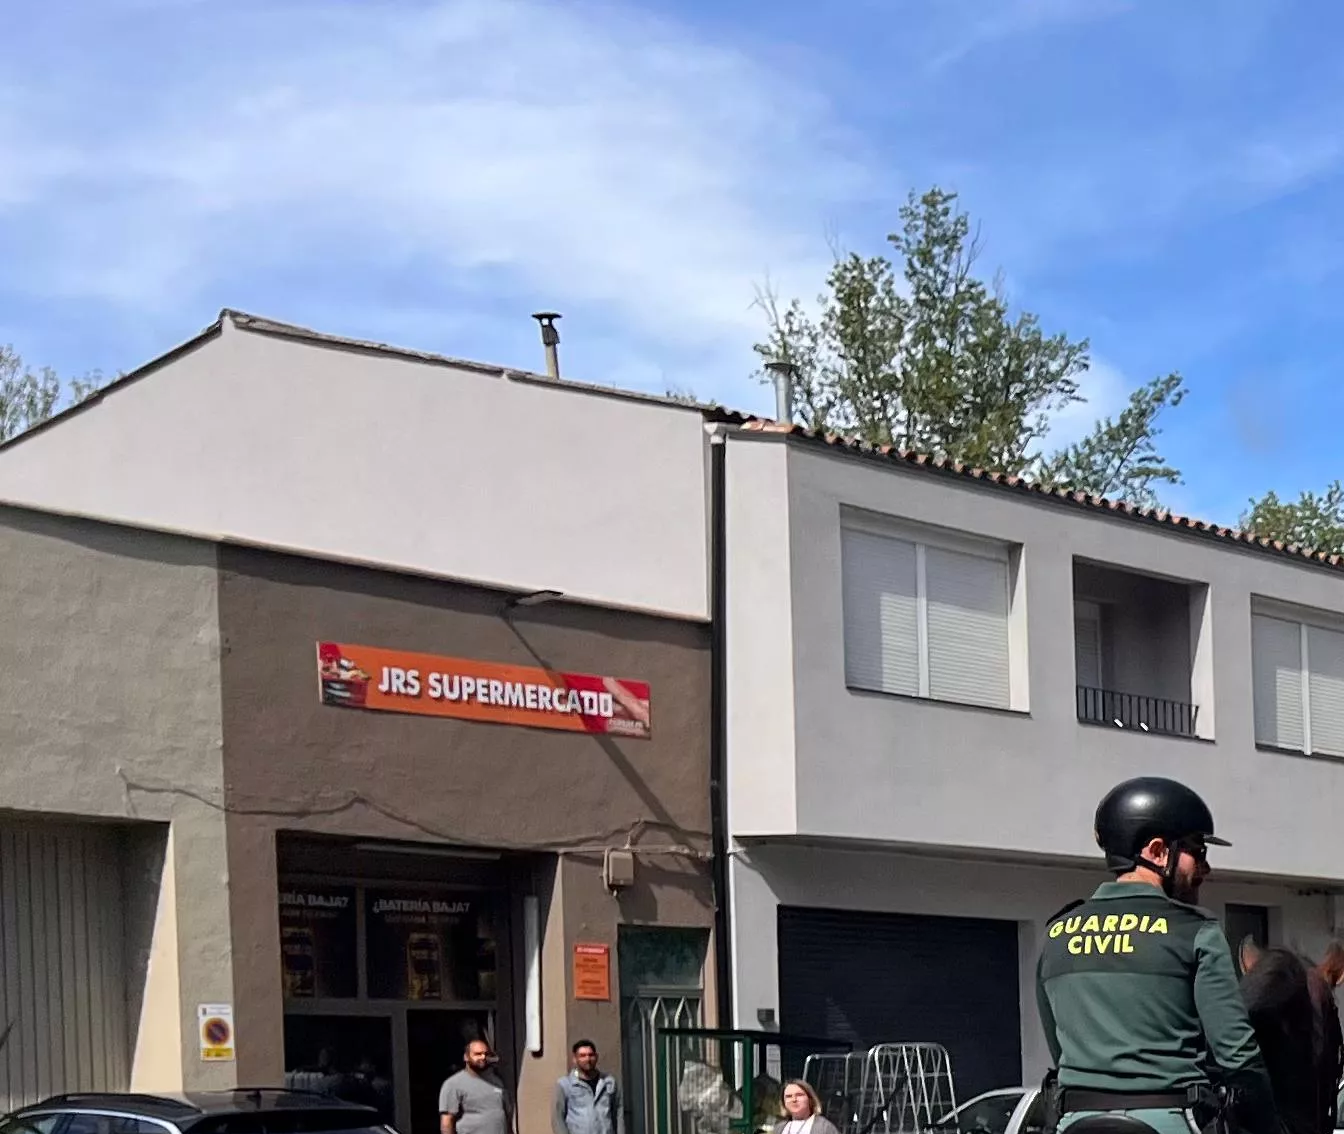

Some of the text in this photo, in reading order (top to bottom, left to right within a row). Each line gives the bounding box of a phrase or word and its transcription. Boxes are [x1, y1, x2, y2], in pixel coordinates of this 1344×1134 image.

[378, 666, 614, 718] JRS SUPERMERCADO
[1049, 913, 1168, 938] GUARDIA
[1067, 934, 1134, 954] CIVIL
